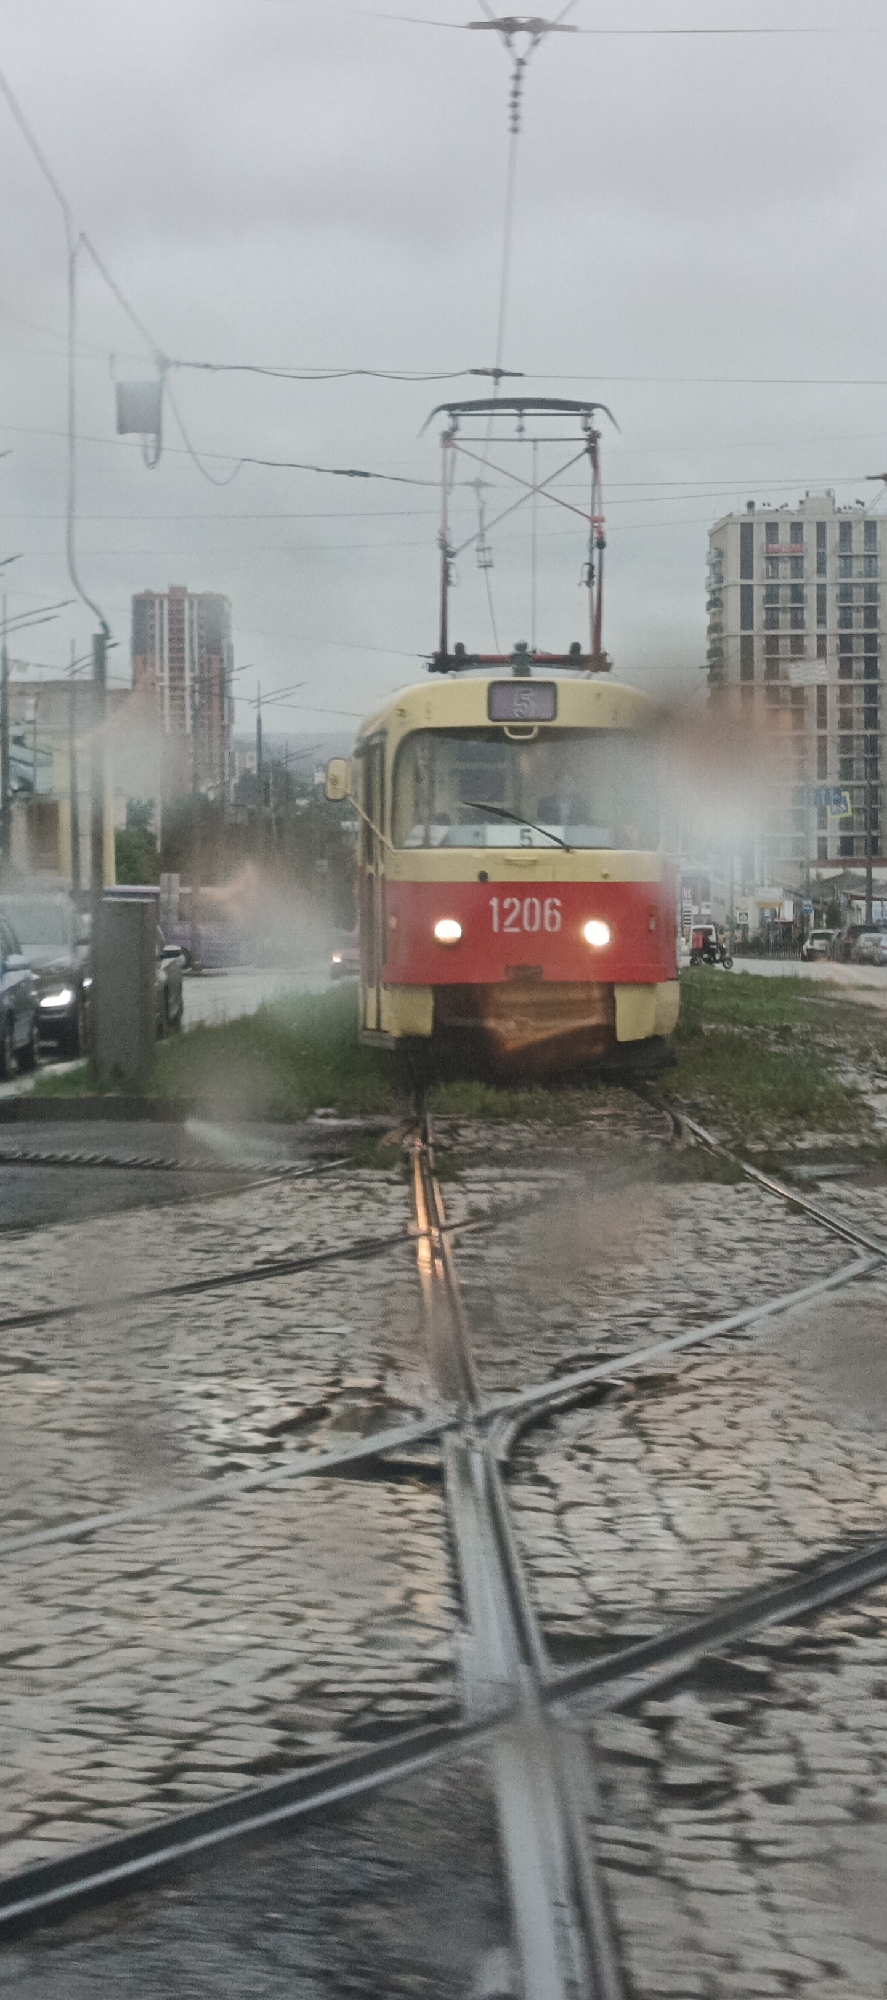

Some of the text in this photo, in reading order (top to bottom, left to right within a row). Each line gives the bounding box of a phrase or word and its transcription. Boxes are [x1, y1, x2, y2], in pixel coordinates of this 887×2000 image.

[513, 688, 534, 718] 5
[519, 828, 533, 847] 5
[489, 897, 562, 932] 1206
